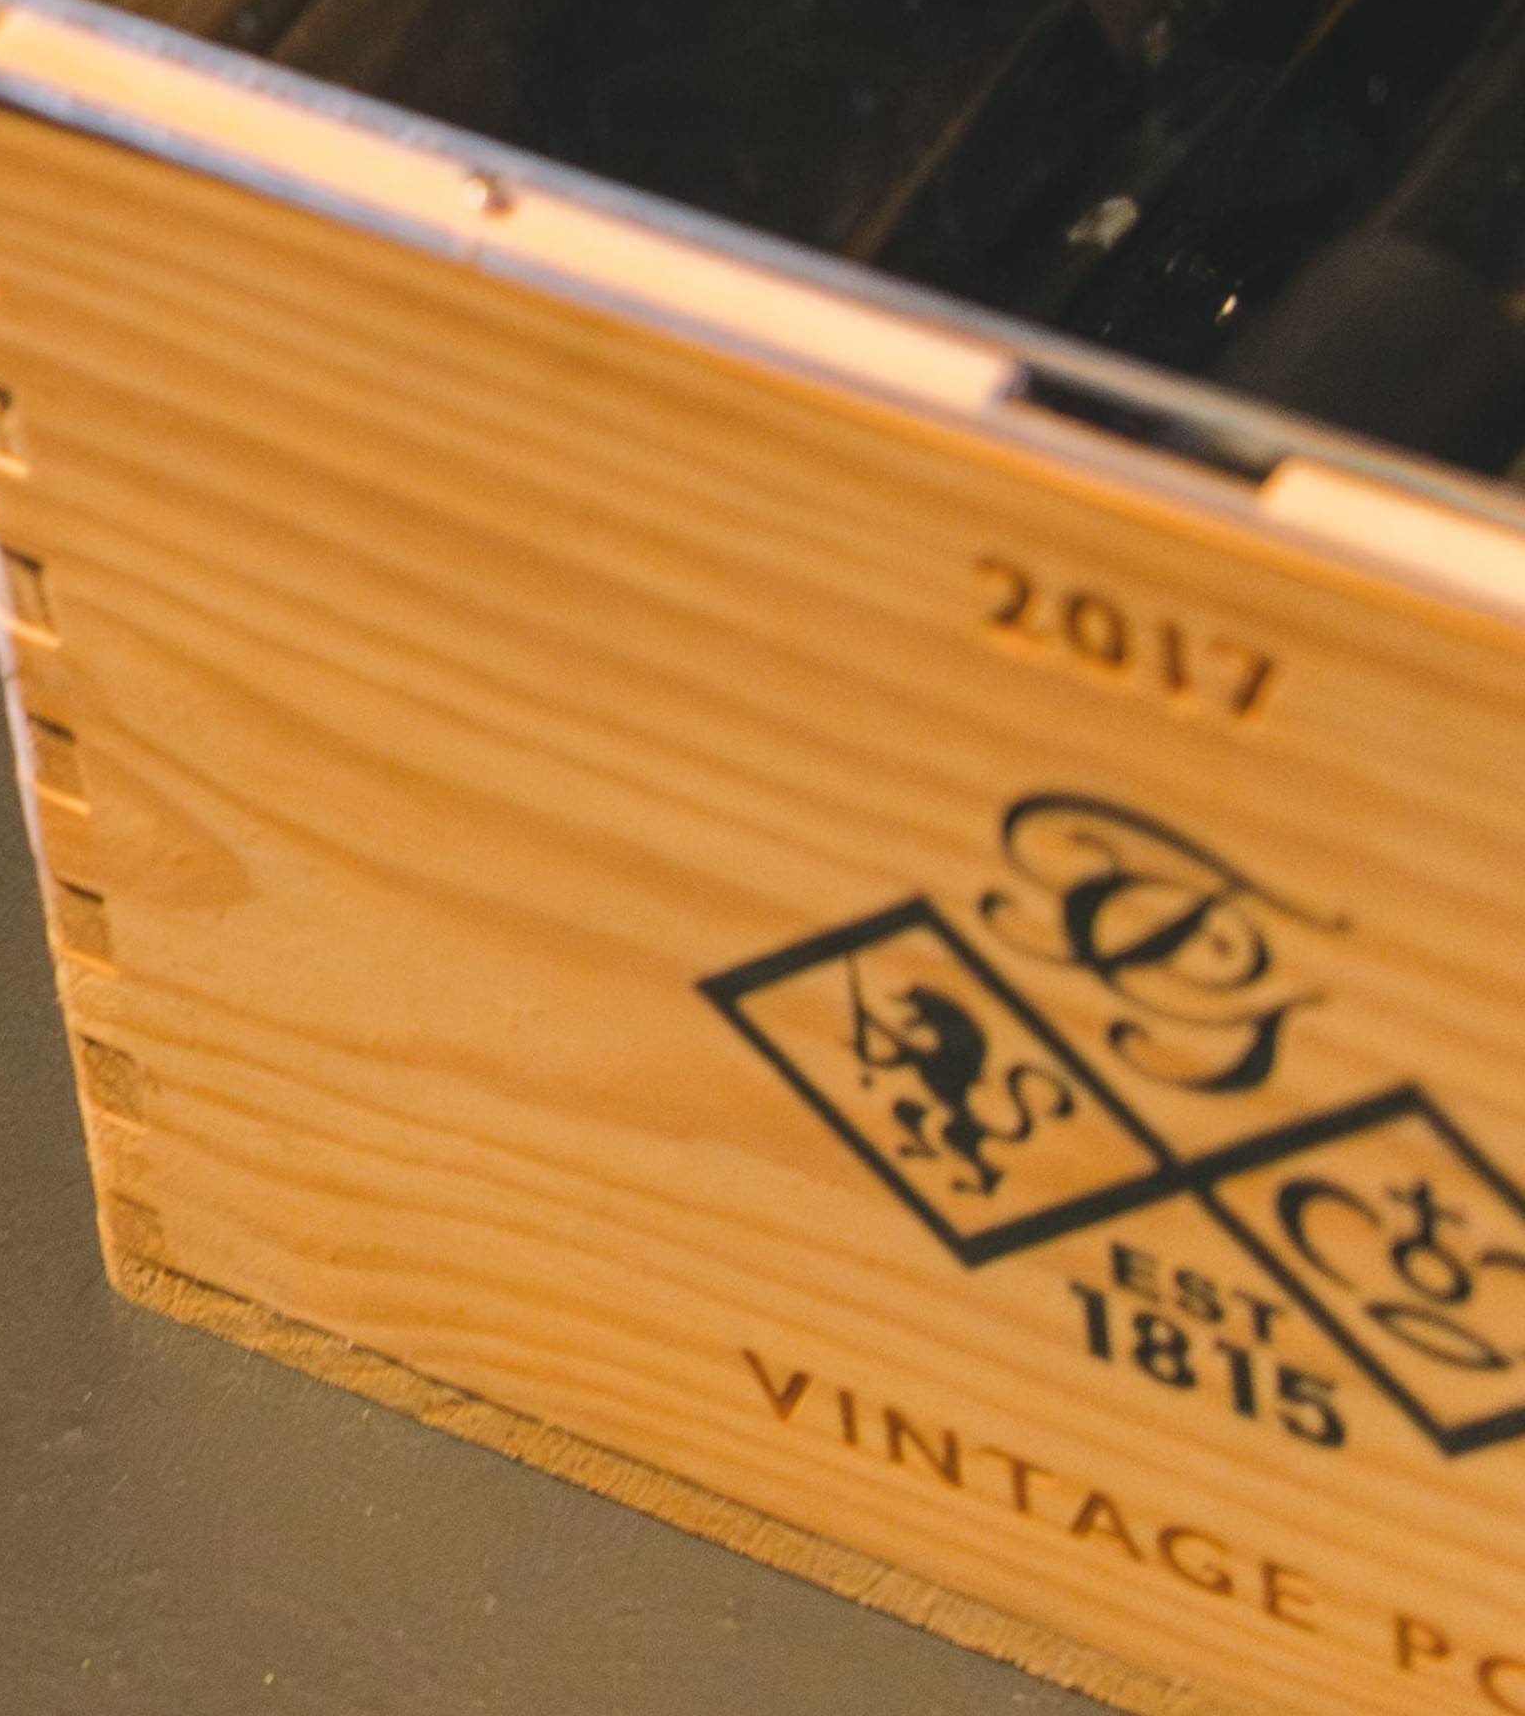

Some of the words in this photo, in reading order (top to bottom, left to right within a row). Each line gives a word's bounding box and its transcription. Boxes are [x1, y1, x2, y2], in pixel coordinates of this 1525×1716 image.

[969, 554, 1277, 720] 2017
[1069, 1280, 1347, 1448] 1815
[1109, 1242, 1286, 1343] EST
[742, 1346, 1323, 1634] VINTAGE
[1392, 1610, 1525, 1716] PO
